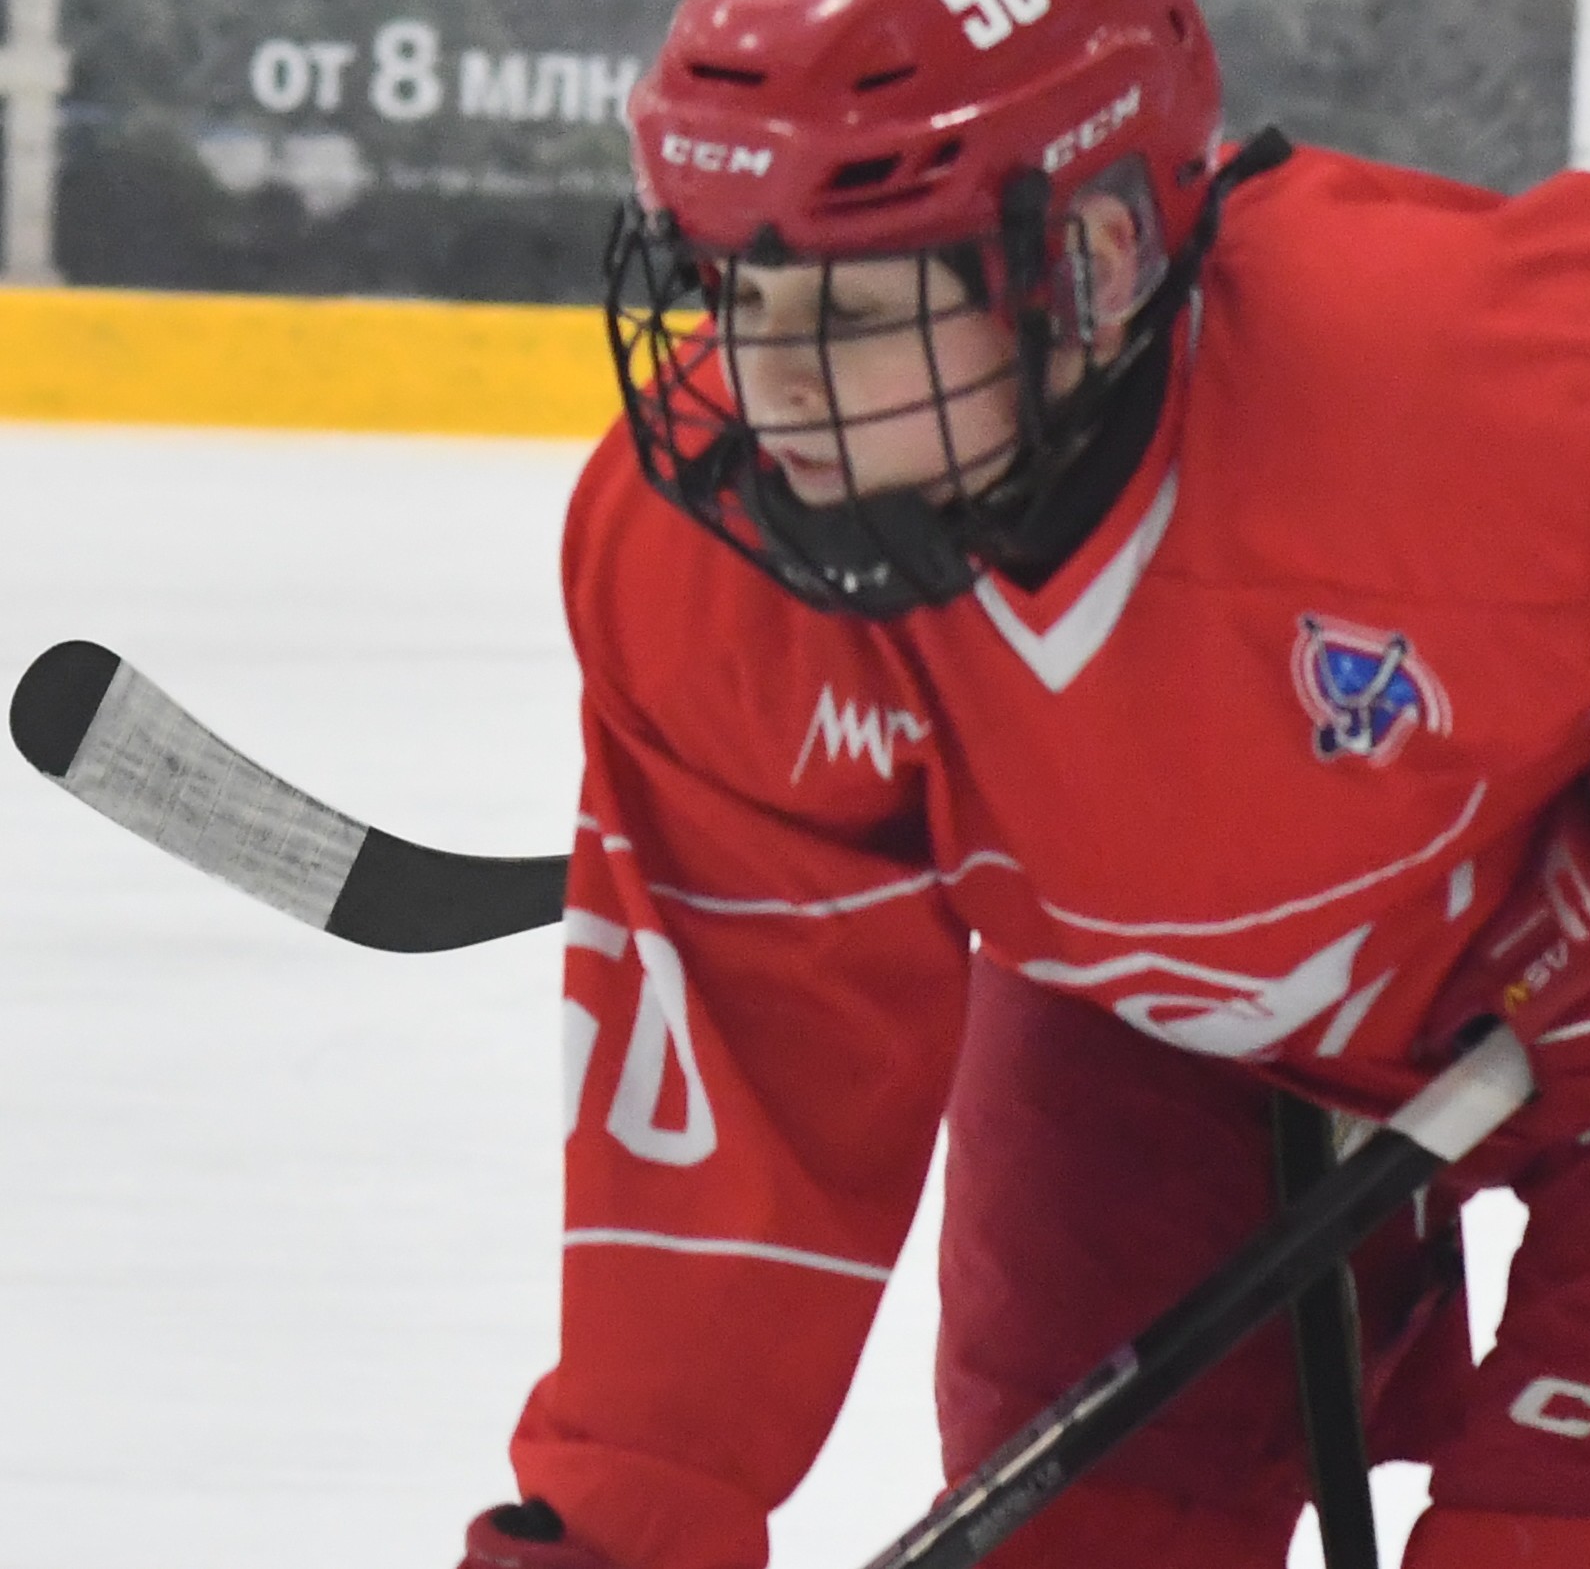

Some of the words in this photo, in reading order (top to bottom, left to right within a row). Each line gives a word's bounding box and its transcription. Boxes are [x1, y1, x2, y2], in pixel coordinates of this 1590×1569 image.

[370, 20, 443, 121] 8
[661, 133, 773, 178] CCM
[1042, 84, 1141, 174] CCM
